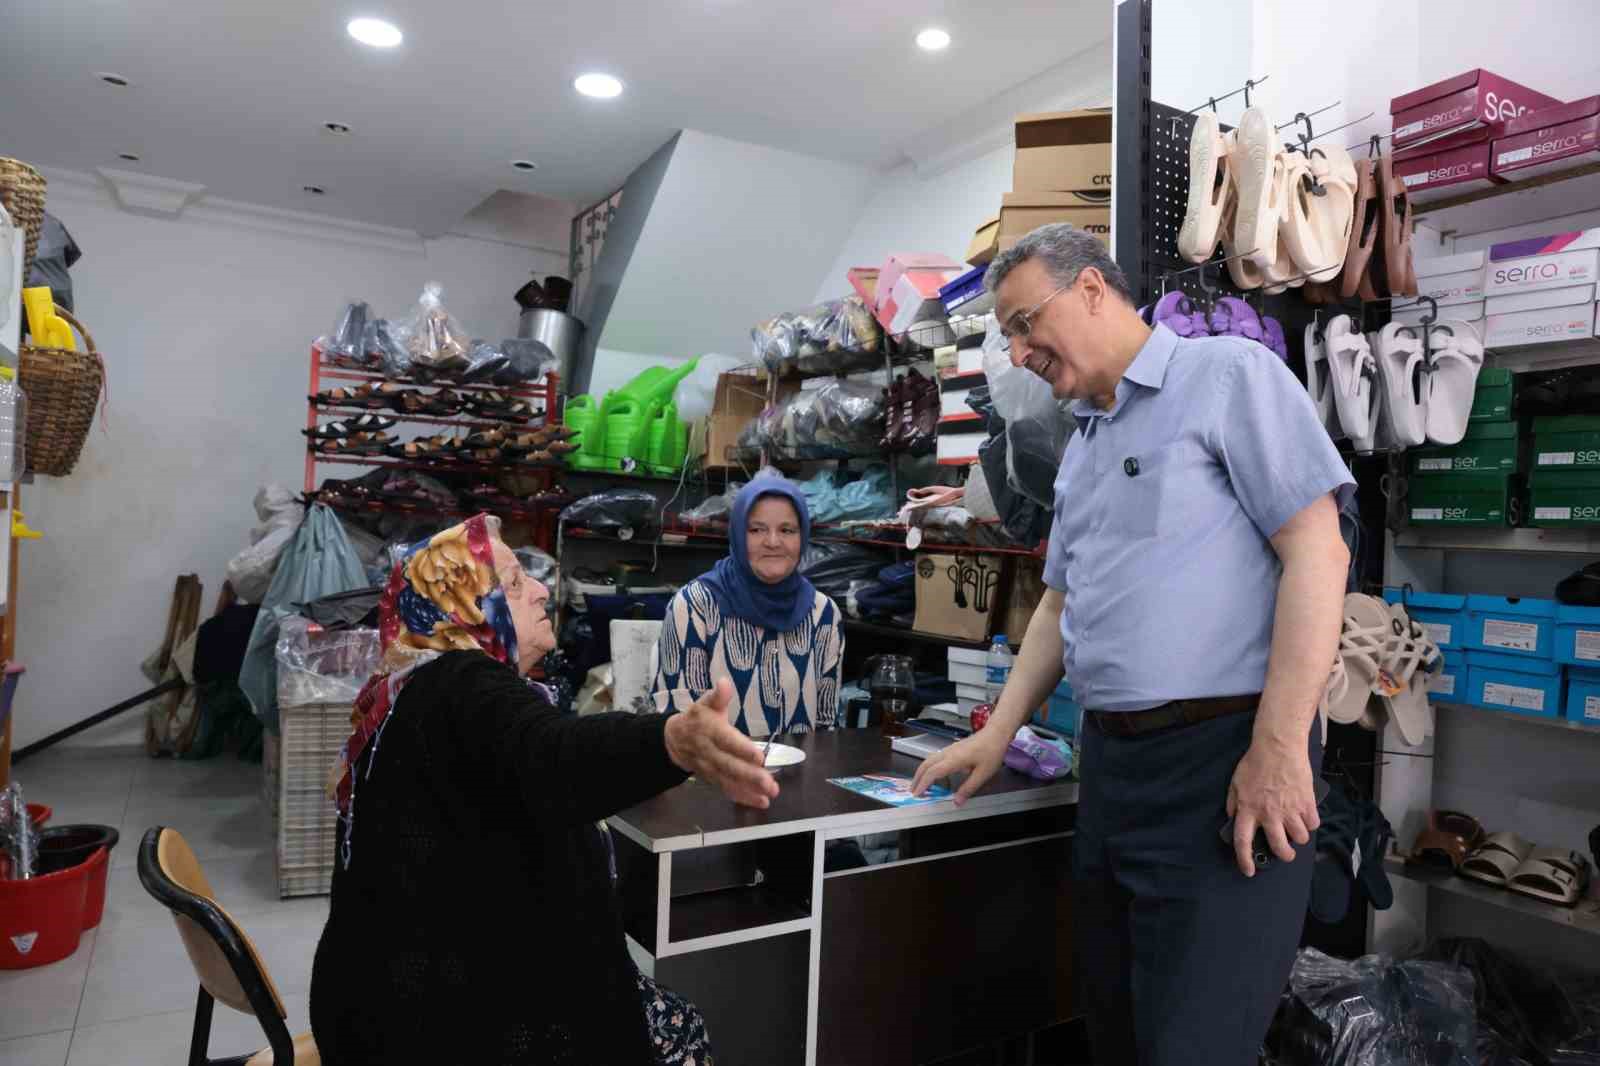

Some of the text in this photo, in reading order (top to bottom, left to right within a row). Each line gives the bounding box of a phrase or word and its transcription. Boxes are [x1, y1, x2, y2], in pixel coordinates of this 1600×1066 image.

[1532, 135, 1578, 156] serra
[1429, 164, 1468, 179] serra
[1084, 224, 1111, 233] cro
[1495, 263, 1558, 284] serra
